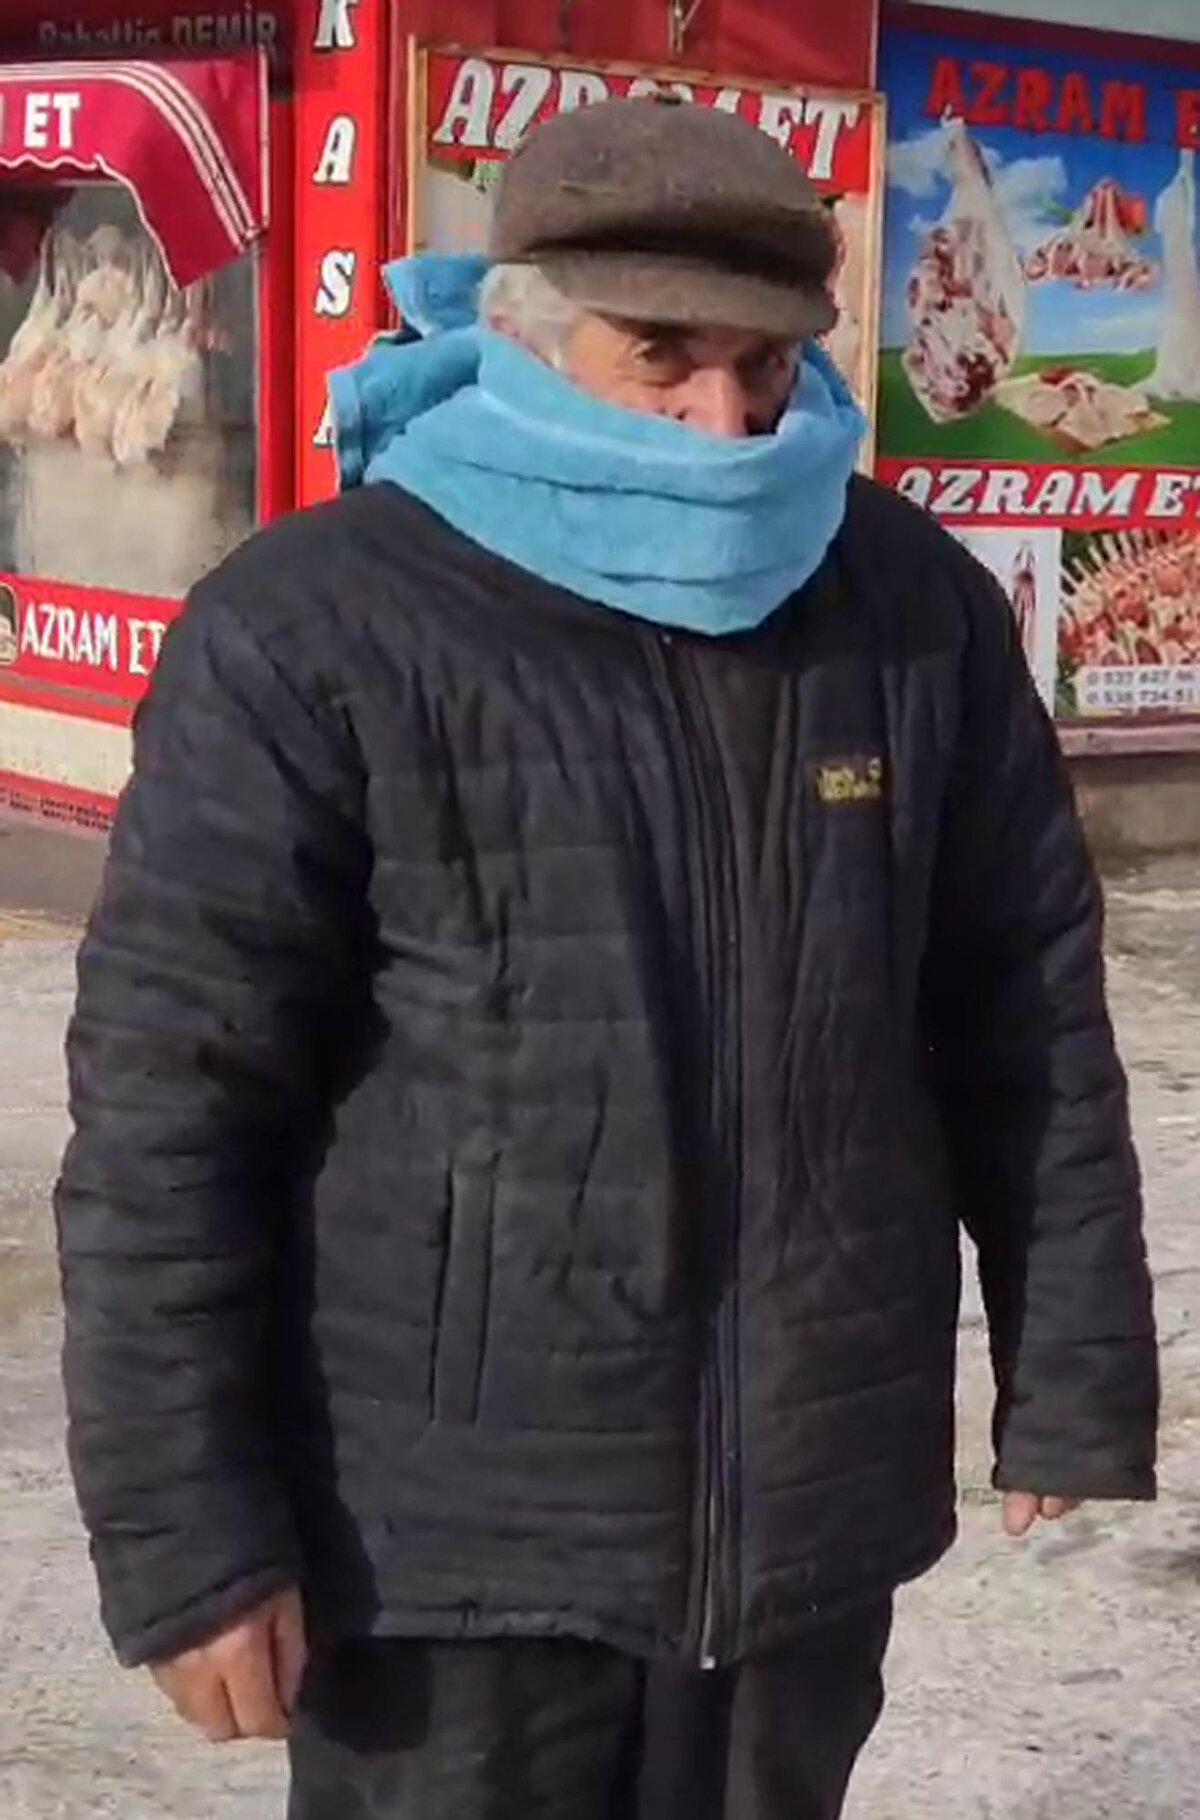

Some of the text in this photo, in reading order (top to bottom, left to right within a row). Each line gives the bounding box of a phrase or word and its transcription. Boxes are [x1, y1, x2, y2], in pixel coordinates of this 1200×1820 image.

[24, 92, 82, 149] ET
[925, 57, 1146, 143] AZRAM
[897, 466, 1141, 516] AZRAM
[21, 599, 118, 672] AZRAM
